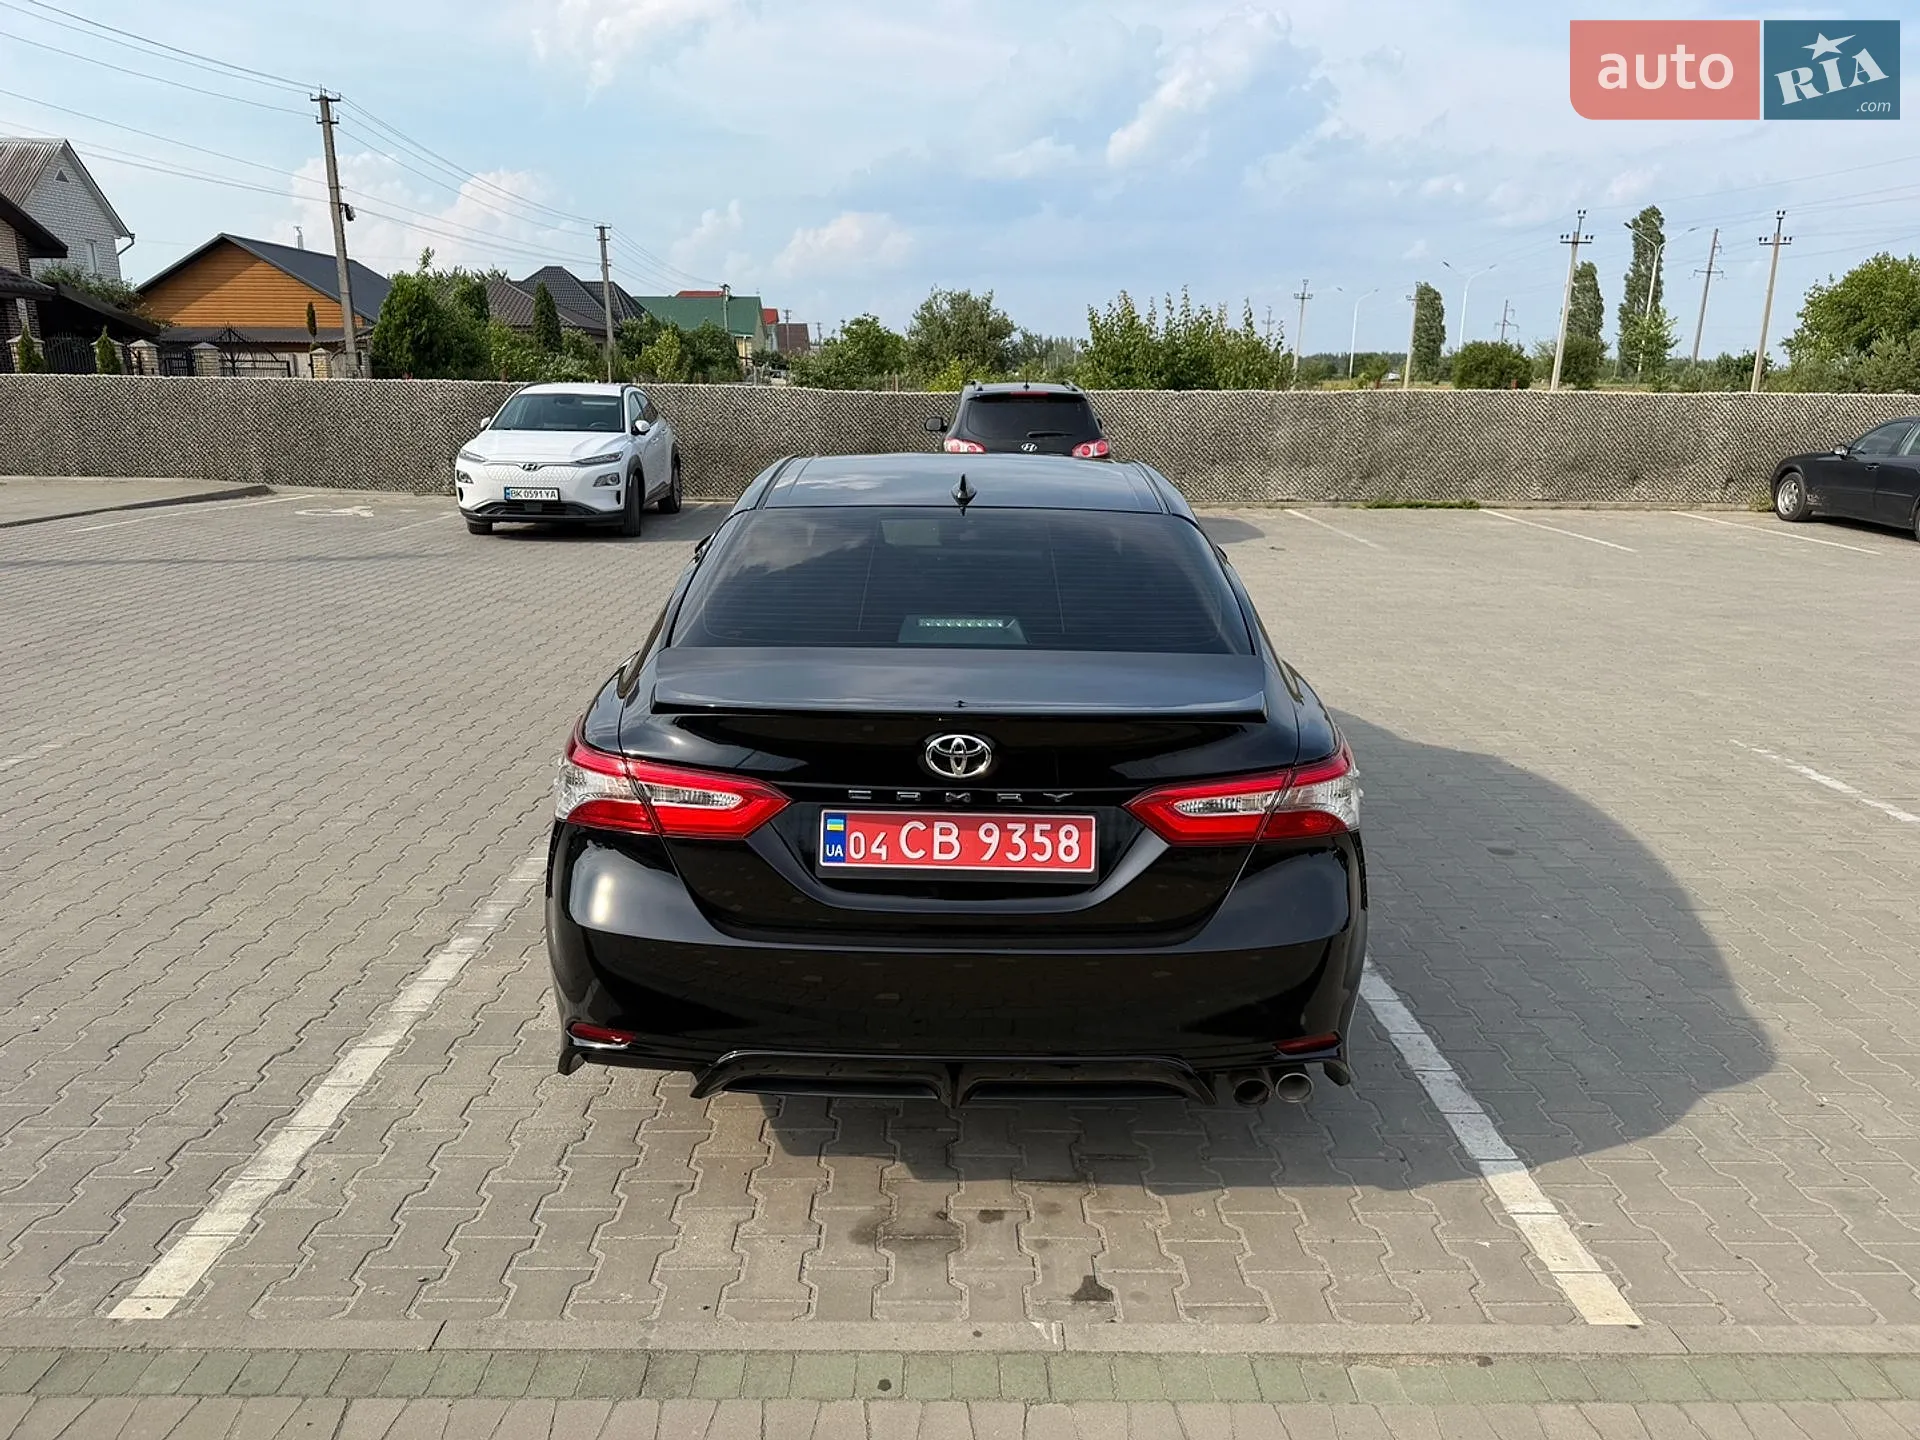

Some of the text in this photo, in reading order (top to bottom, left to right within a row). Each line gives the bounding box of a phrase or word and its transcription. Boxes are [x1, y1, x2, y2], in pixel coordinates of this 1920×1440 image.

[524, 490, 543, 498] 0591
[849, 821, 1080, 863] 04 CB 9358
[826, 844, 843, 857] UA
